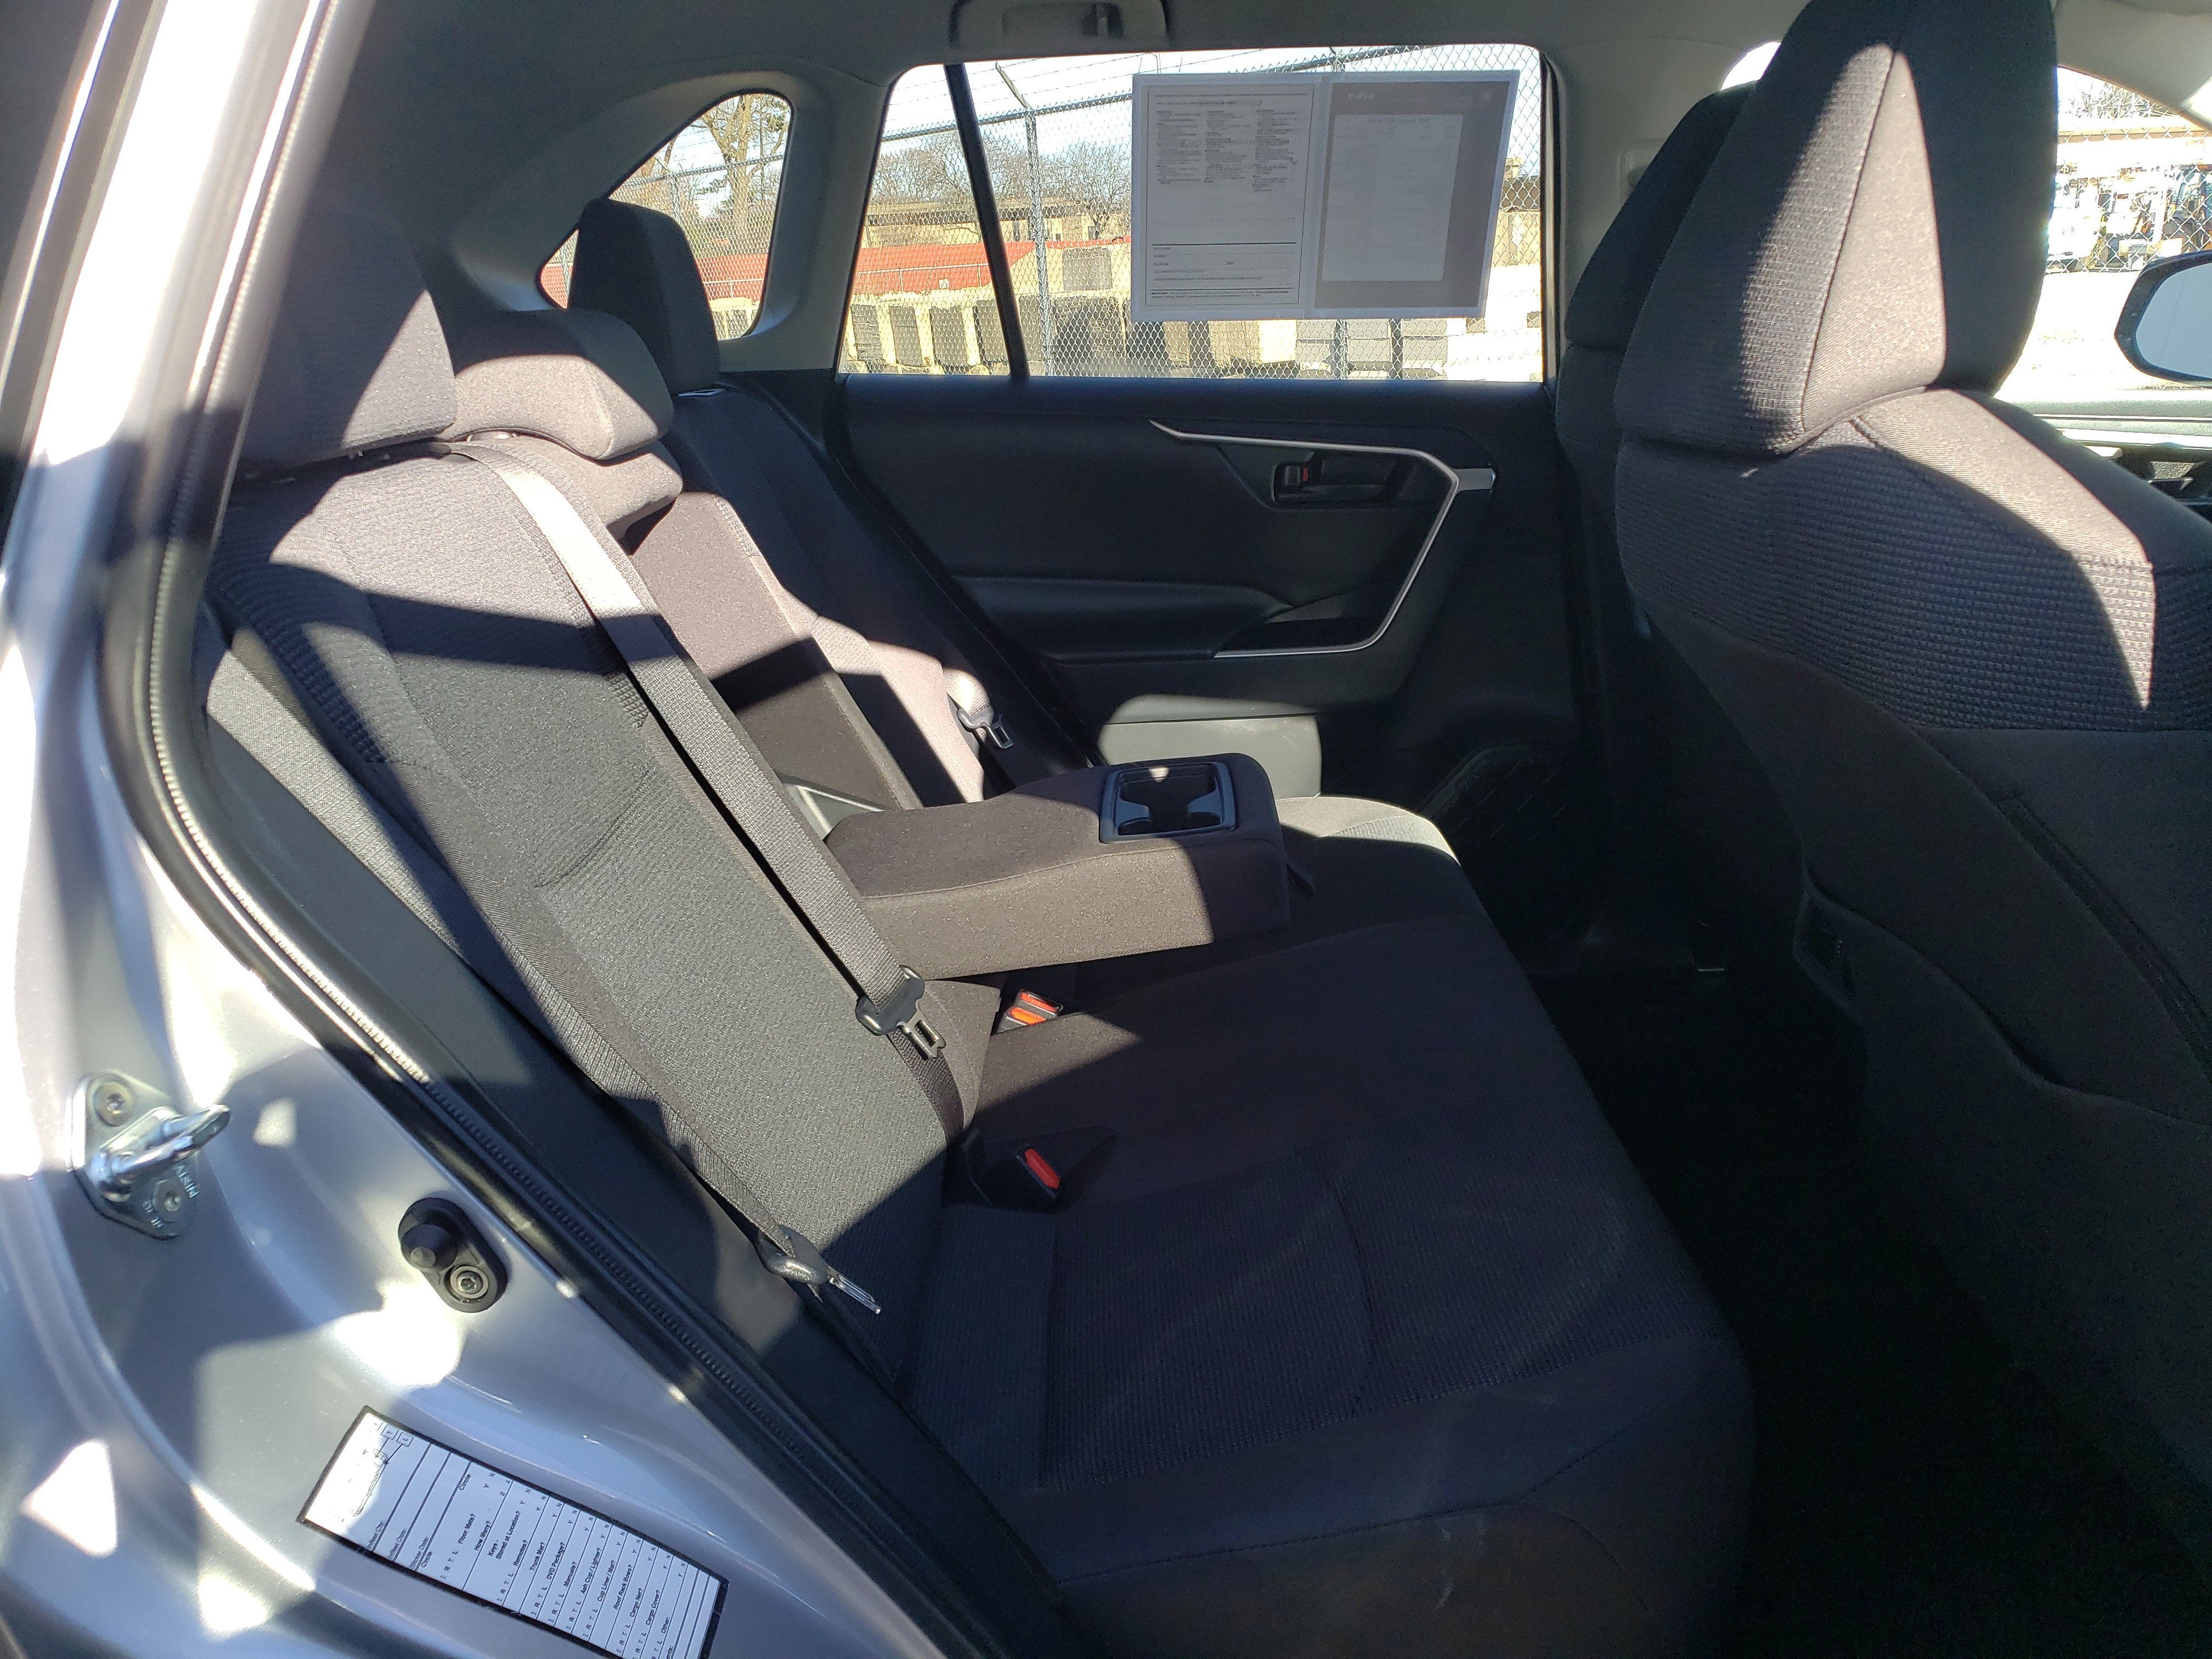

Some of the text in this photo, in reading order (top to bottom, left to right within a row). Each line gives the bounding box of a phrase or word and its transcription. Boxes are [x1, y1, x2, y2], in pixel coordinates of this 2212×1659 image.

[174, 1165, 200, 1198] AISIN
[421, 1474, 471, 1567] Circle Circle
[458, 1530, 468, 1544] Floor
[465, 1514, 475, 1529] Mats?
[474, 1539, 483, 1551] How
[480, 1521, 491, 1538] Many?
[496, 1542, 507, 1559] Stored
[506, 1511, 521, 1536] Location?
[488, 1543, 498, 1556] Keys
[513, 1539, 528, 1566] Remotes?
[529, 1556, 540, 1570] Trunk
[546, 1567, 555, 1579] DVD
[551, 1542, 565, 1567] Package?
[590, 1547, 601, 1568] Lighter?
[563, 1561, 577, 1587] Manuals?
[601, 1576, 610, 1590] Liner
[613, 1596, 622, 1610] Roof
[618, 1583, 627, 1596] Rack
[623, 1564, 633, 1582] Bows?
[630, 1601, 639, 1617] Cargo
[646, 1609, 654, 1625] Cargo
[651, 1589, 660, 1609] Cover?
[661, 1617, 670, 1633] Other:
